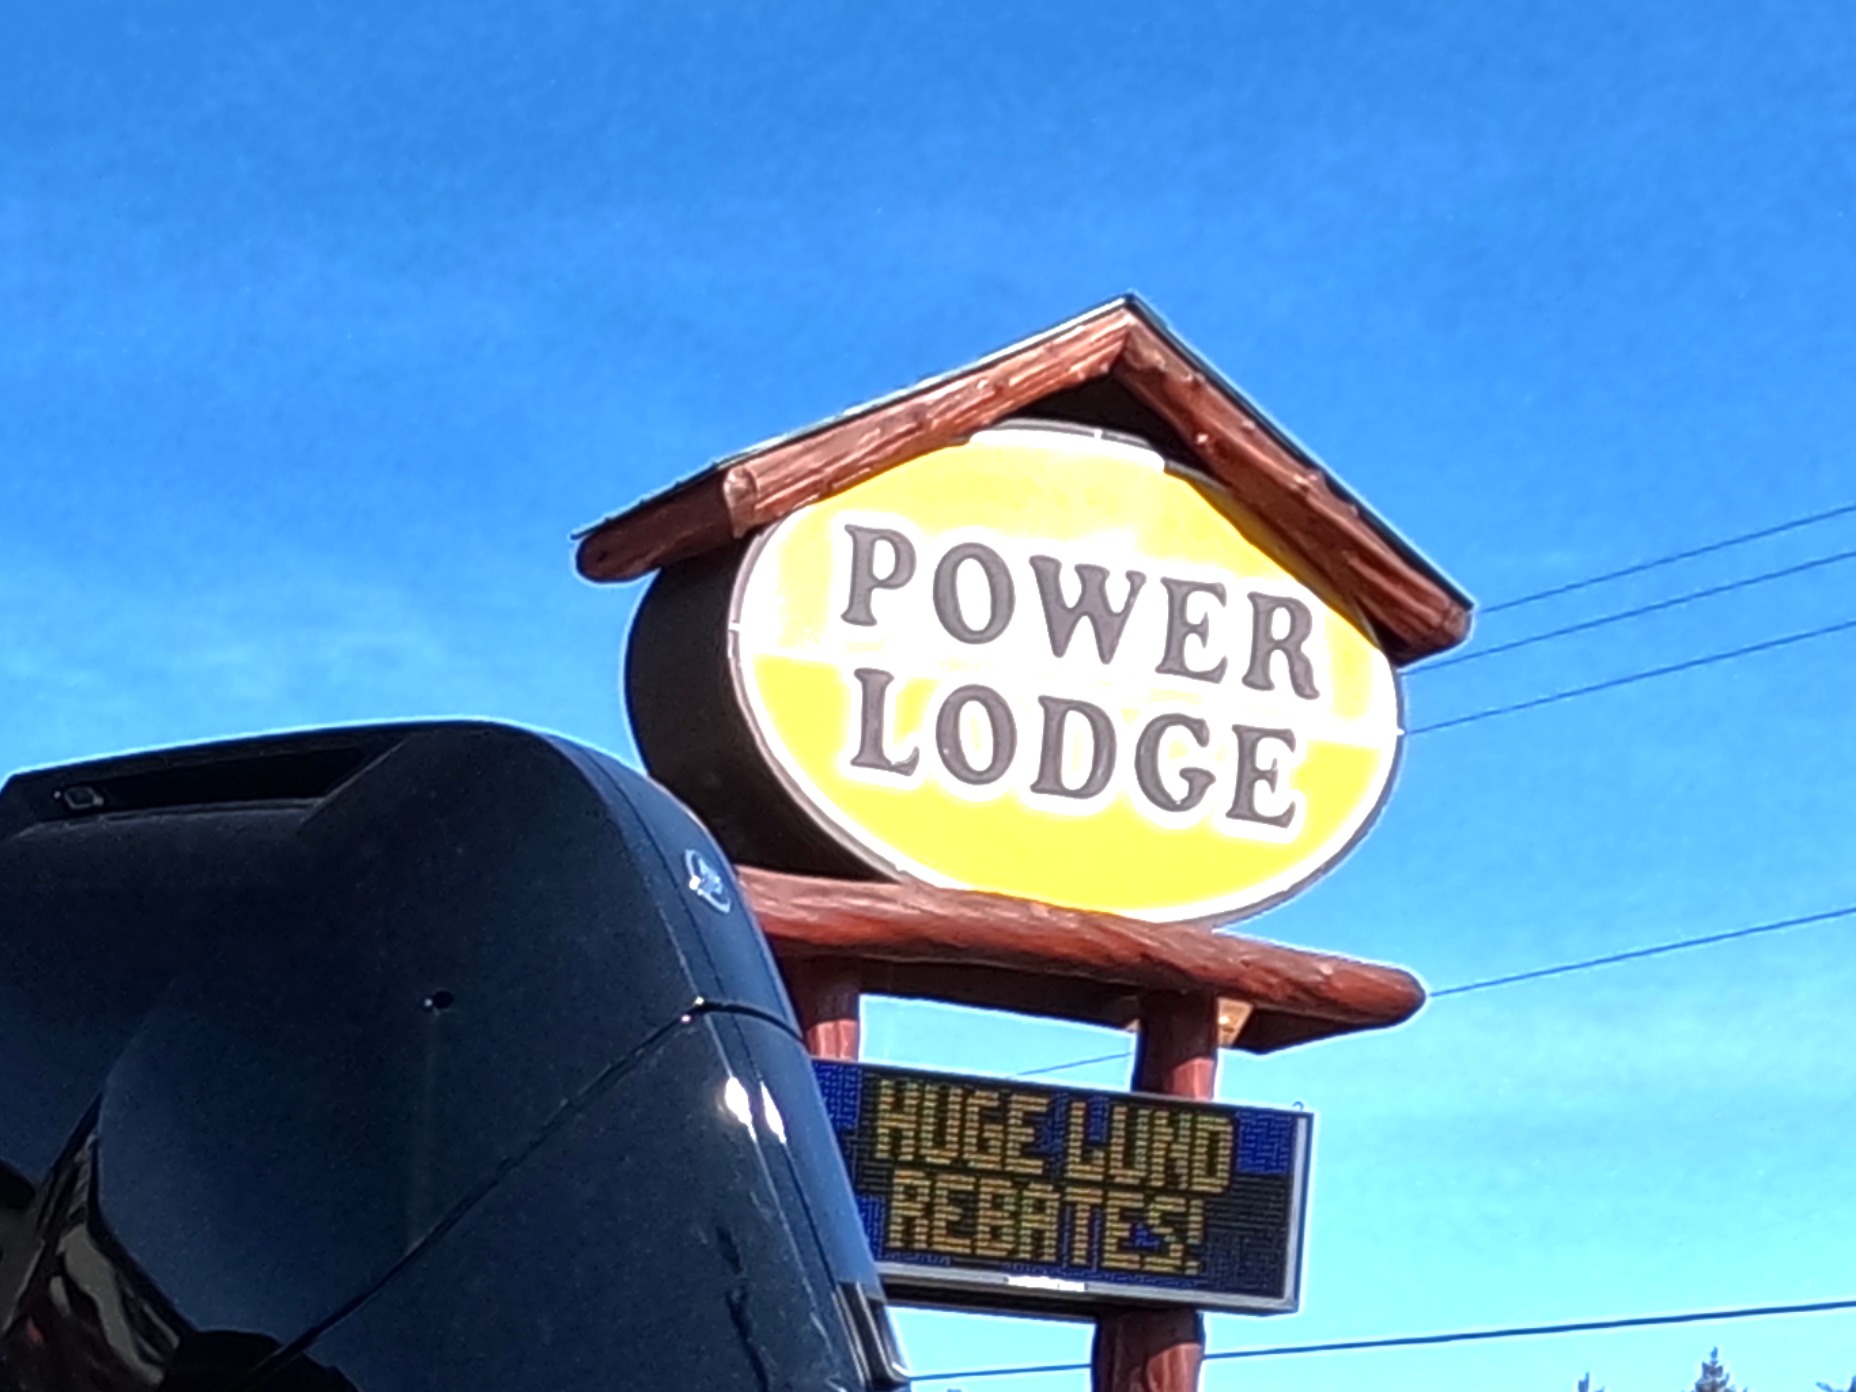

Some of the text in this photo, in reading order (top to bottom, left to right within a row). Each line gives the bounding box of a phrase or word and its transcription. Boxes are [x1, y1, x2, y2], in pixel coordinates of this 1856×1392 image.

[840, 523, 1320, 700] POWER
[850, 667, 1296, 829] LODGE
[874, 1078, 1234, 1195] HUGE LUND
[889, 1168, 1204, 1276] REBATES!
